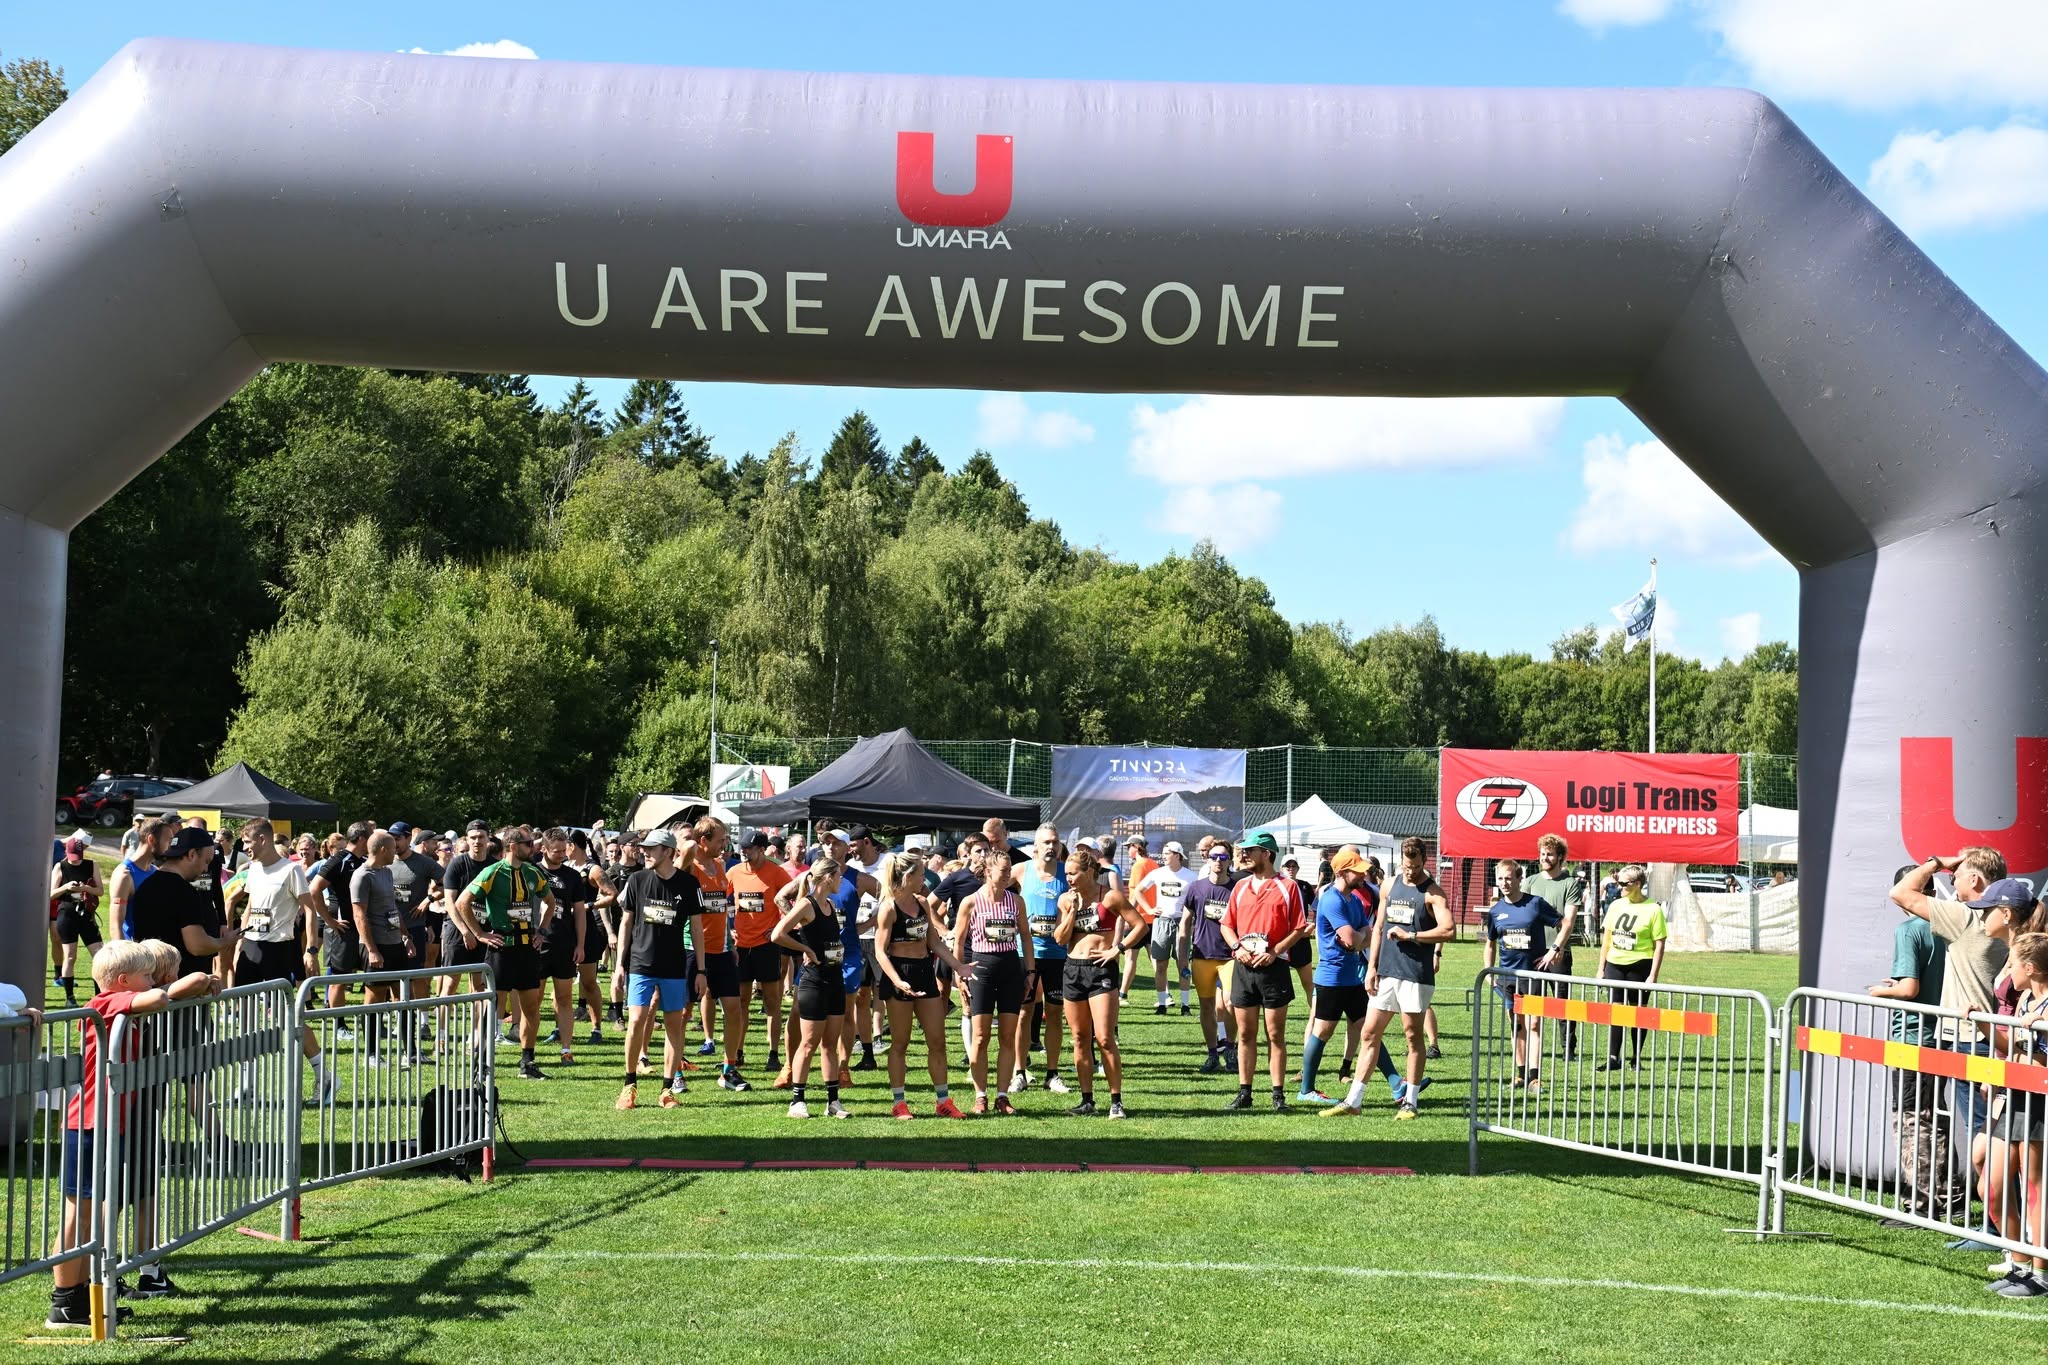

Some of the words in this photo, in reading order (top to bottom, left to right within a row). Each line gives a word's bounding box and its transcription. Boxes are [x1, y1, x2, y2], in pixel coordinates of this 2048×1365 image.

[896, 227, 1013, 250] UMARA
[555, 261, 609, 327] U
[650, 266, 829, 335] ARE
[865, 275, 1345, 348] AWESOME
[1566, 781, 1626, 812] Logi
[1633, 782, 1718, 812] Trans
[1566, 814, 1644, 834] OFFSHORE
[1648, 816, 1718, 836] EXPRESS
[655, 909, 665, 917] 75
[1040, 924, 1052, 932] 135
